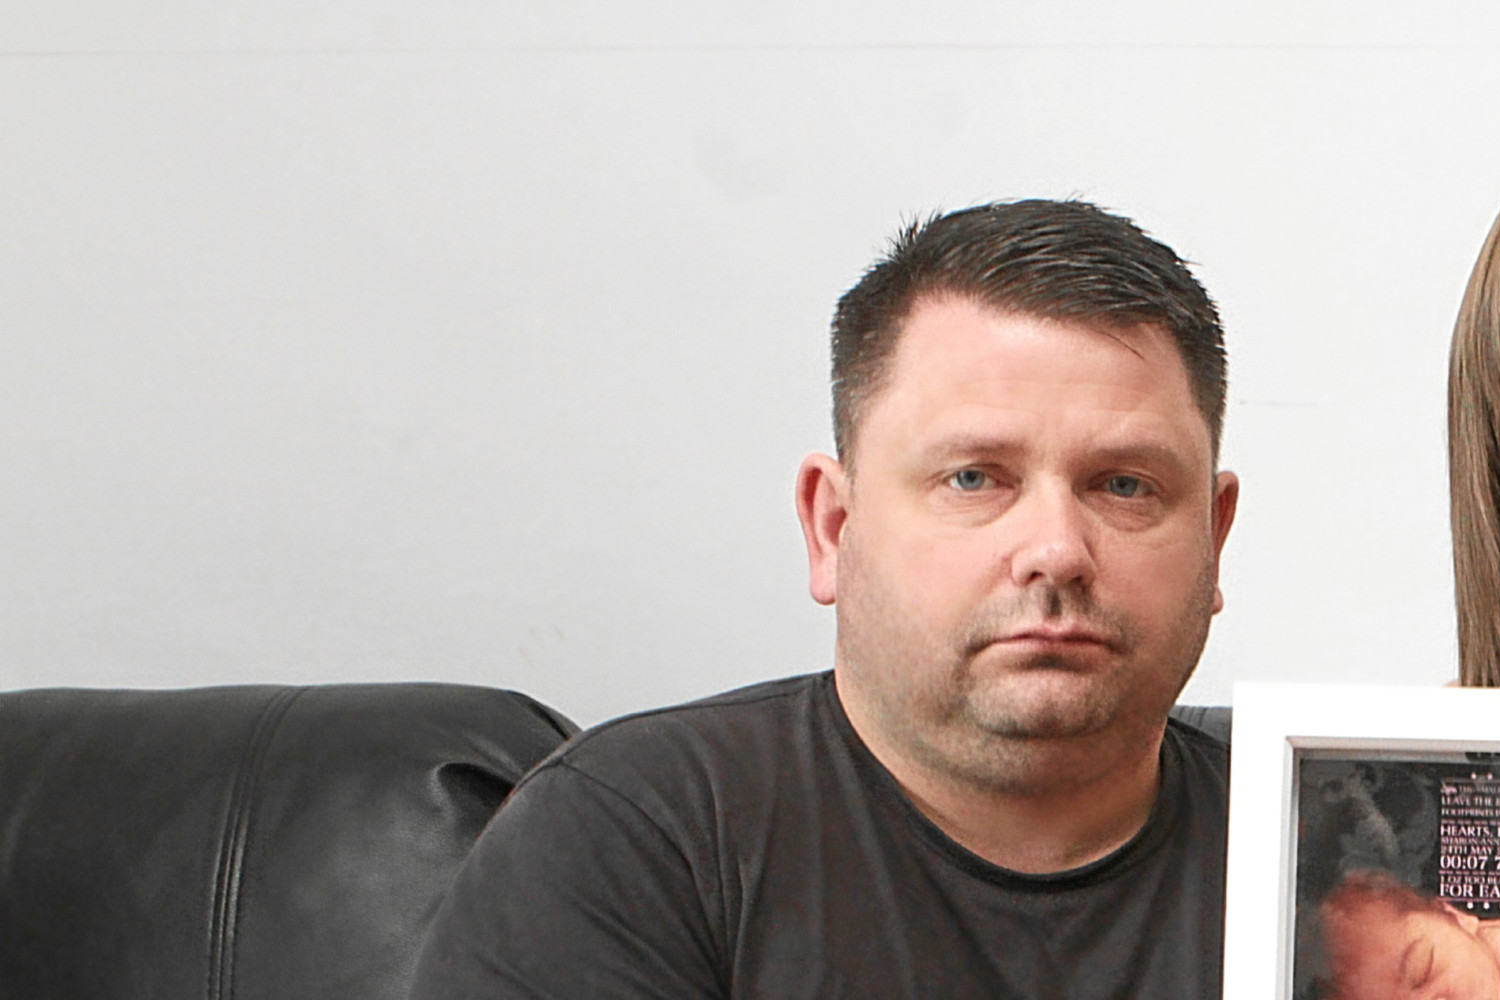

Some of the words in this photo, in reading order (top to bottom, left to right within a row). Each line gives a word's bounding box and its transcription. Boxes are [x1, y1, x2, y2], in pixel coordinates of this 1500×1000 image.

[1441, 796, 1470, 805] LEAVE
[1473, 796, 1492, 806] THE
[1441, 808, 1494, 817] FOOTPRINTS
[1441, 825, 1493, 837] HEARTS,
[1441, 845, 1467, 854] 24TH
[1471, 846, 1492, 854] MAY
[1440, 855, 1488, 869] 00:07
[1447, 876, 1462, 884] OZ
[1464, 876, 1485, 884] TOO
[1440, 884, 1473, 897] FOR
